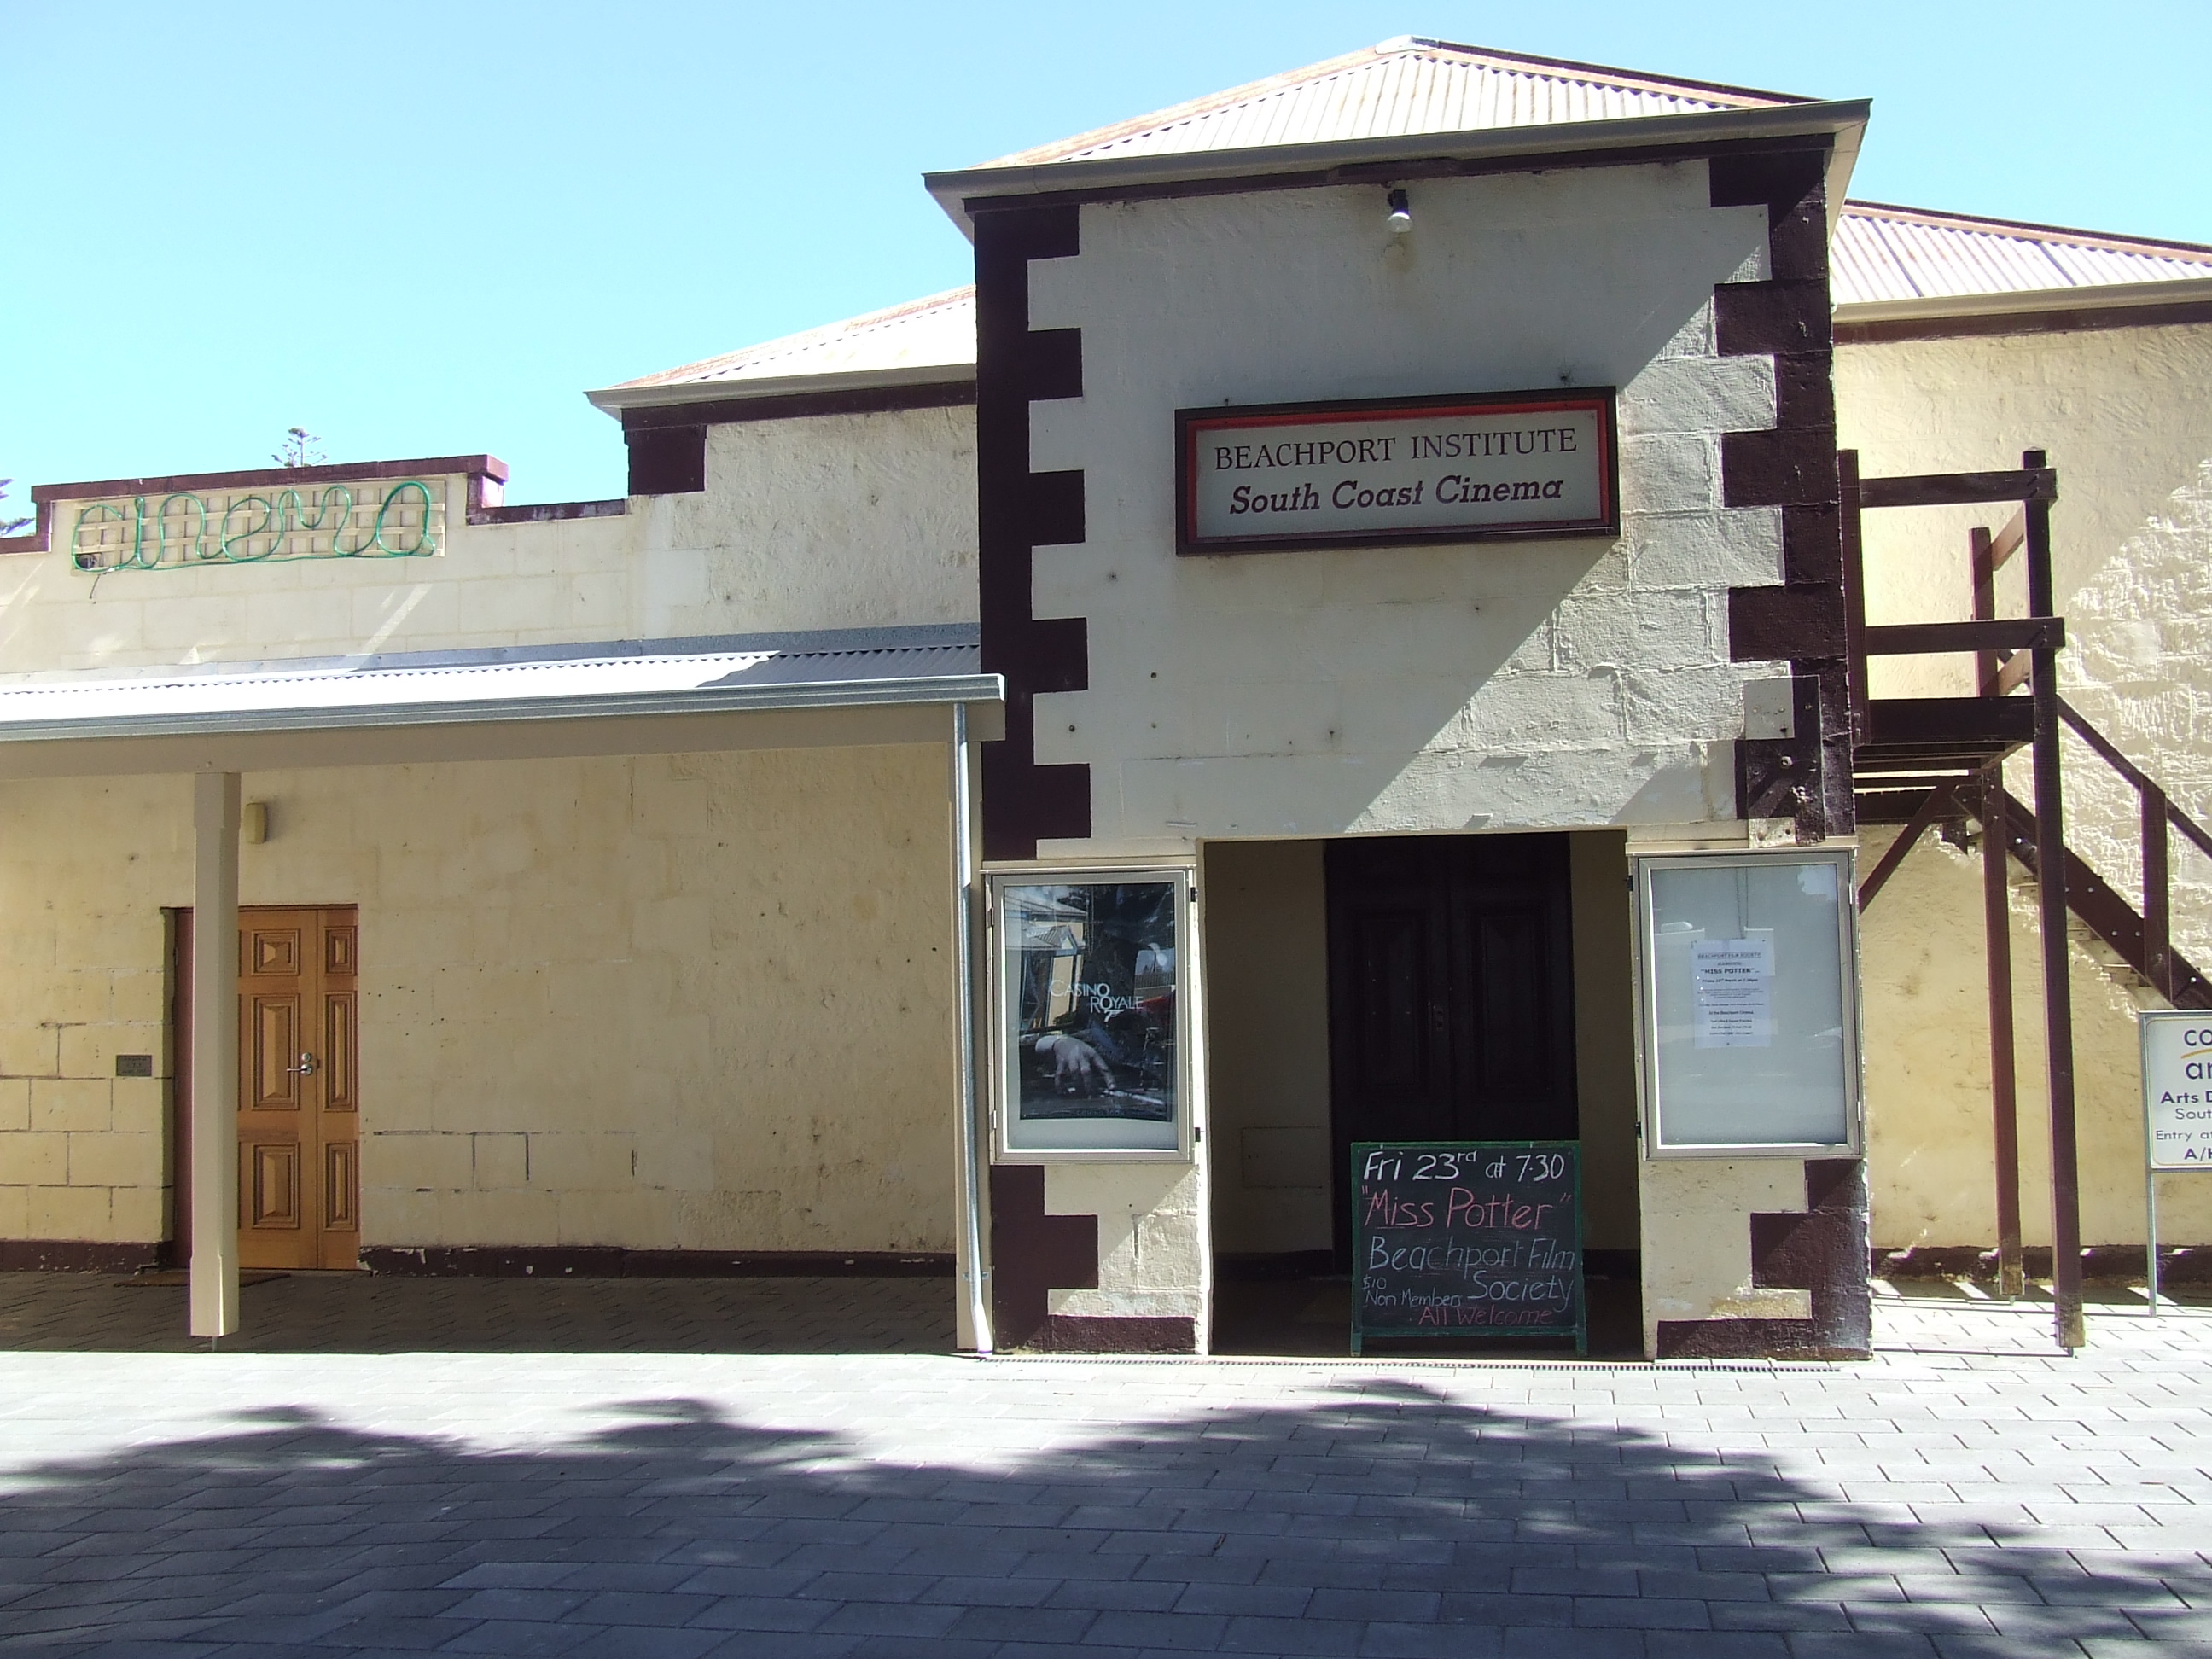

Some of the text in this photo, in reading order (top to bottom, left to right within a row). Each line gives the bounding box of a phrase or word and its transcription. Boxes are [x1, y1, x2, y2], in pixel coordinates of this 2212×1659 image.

[1214, 428, 1578, 471] BEACHPORT INSTITUTE
[1229, 474, 1564, 515] South Coast Cinema
[1050, 979, 1110, 998] CASINO
[1090, 996, 1144, 1014] ROYALE
[2161, 1091, 2199, 1103] Arts
[2156, 1130, 2192, 1142] Entry
[1363, 1150, 1405, 1181] Fri
[1412, 1150, 1478, 1181] 23rd
[1485, 1155, 1507, 1179] at
[1369, 1235, 1575, 1280] Beachport Film
[1362, 1276, 1388, 1290] $10
[1467, 1269, 1575, 1313] Society
[1365, 1287, 1462, 1307] Non Members
[1417, 1304, 1555, 1326] All Welcome
